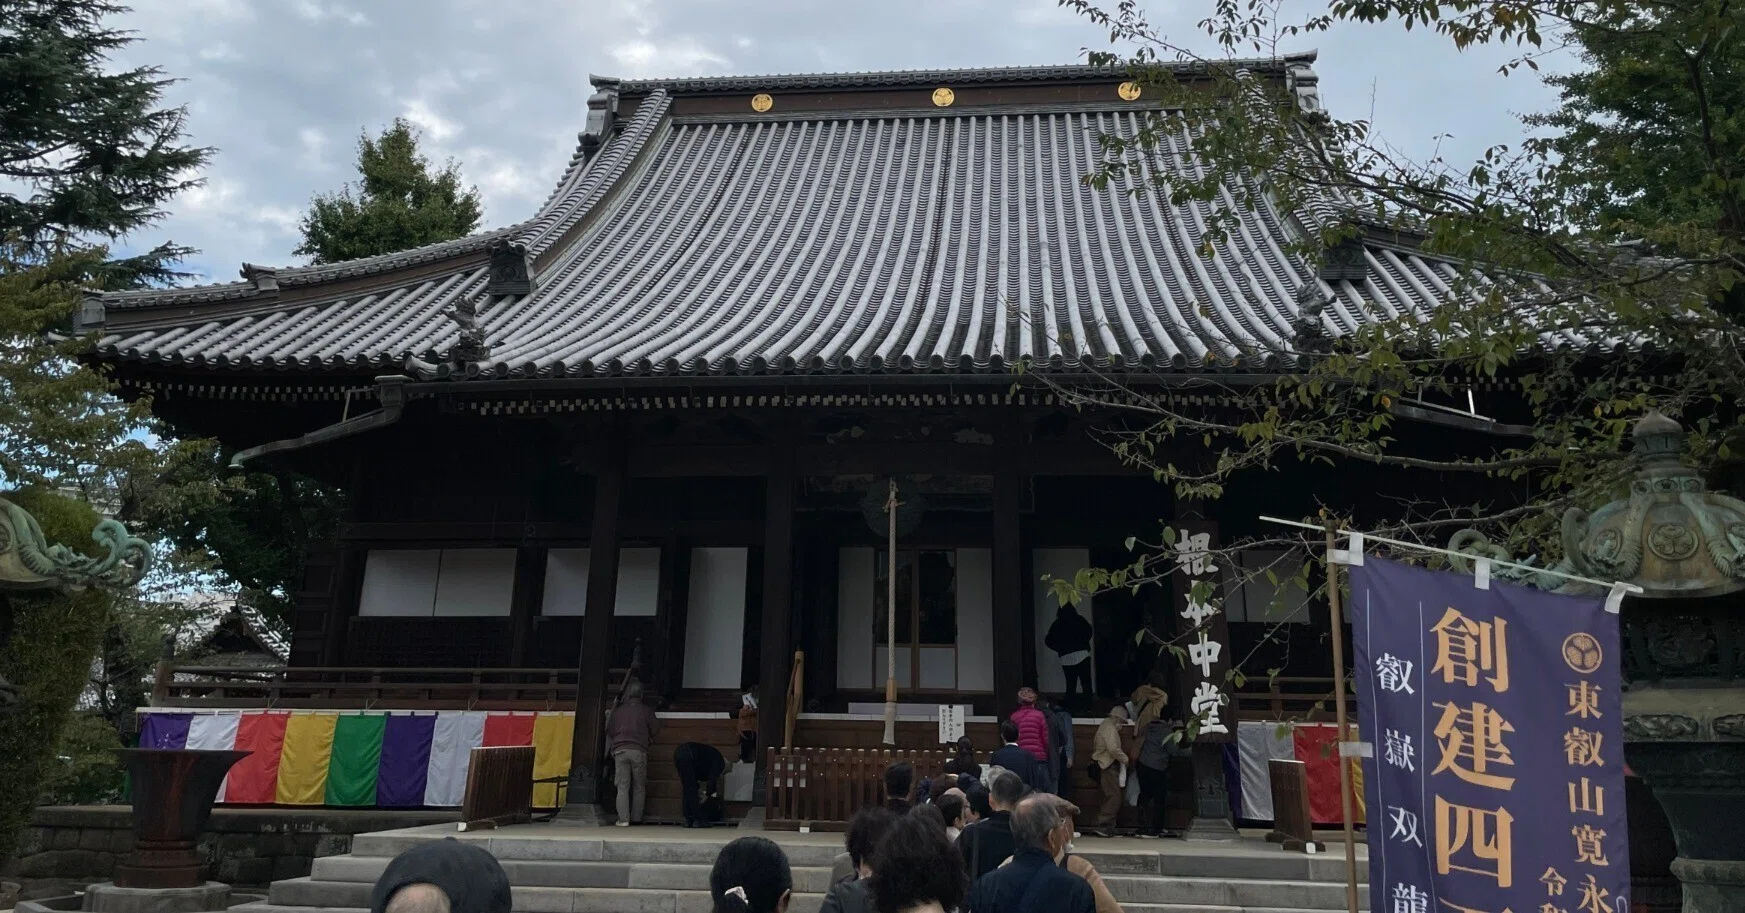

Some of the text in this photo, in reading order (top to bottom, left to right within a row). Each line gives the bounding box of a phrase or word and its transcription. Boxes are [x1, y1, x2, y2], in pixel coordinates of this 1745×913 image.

[1174, 529, 1229, 734] 根本中堂
[1429, 606, 1516, 913] 創建四
[1563, 680, 1614, 913] 東叡山寛永
